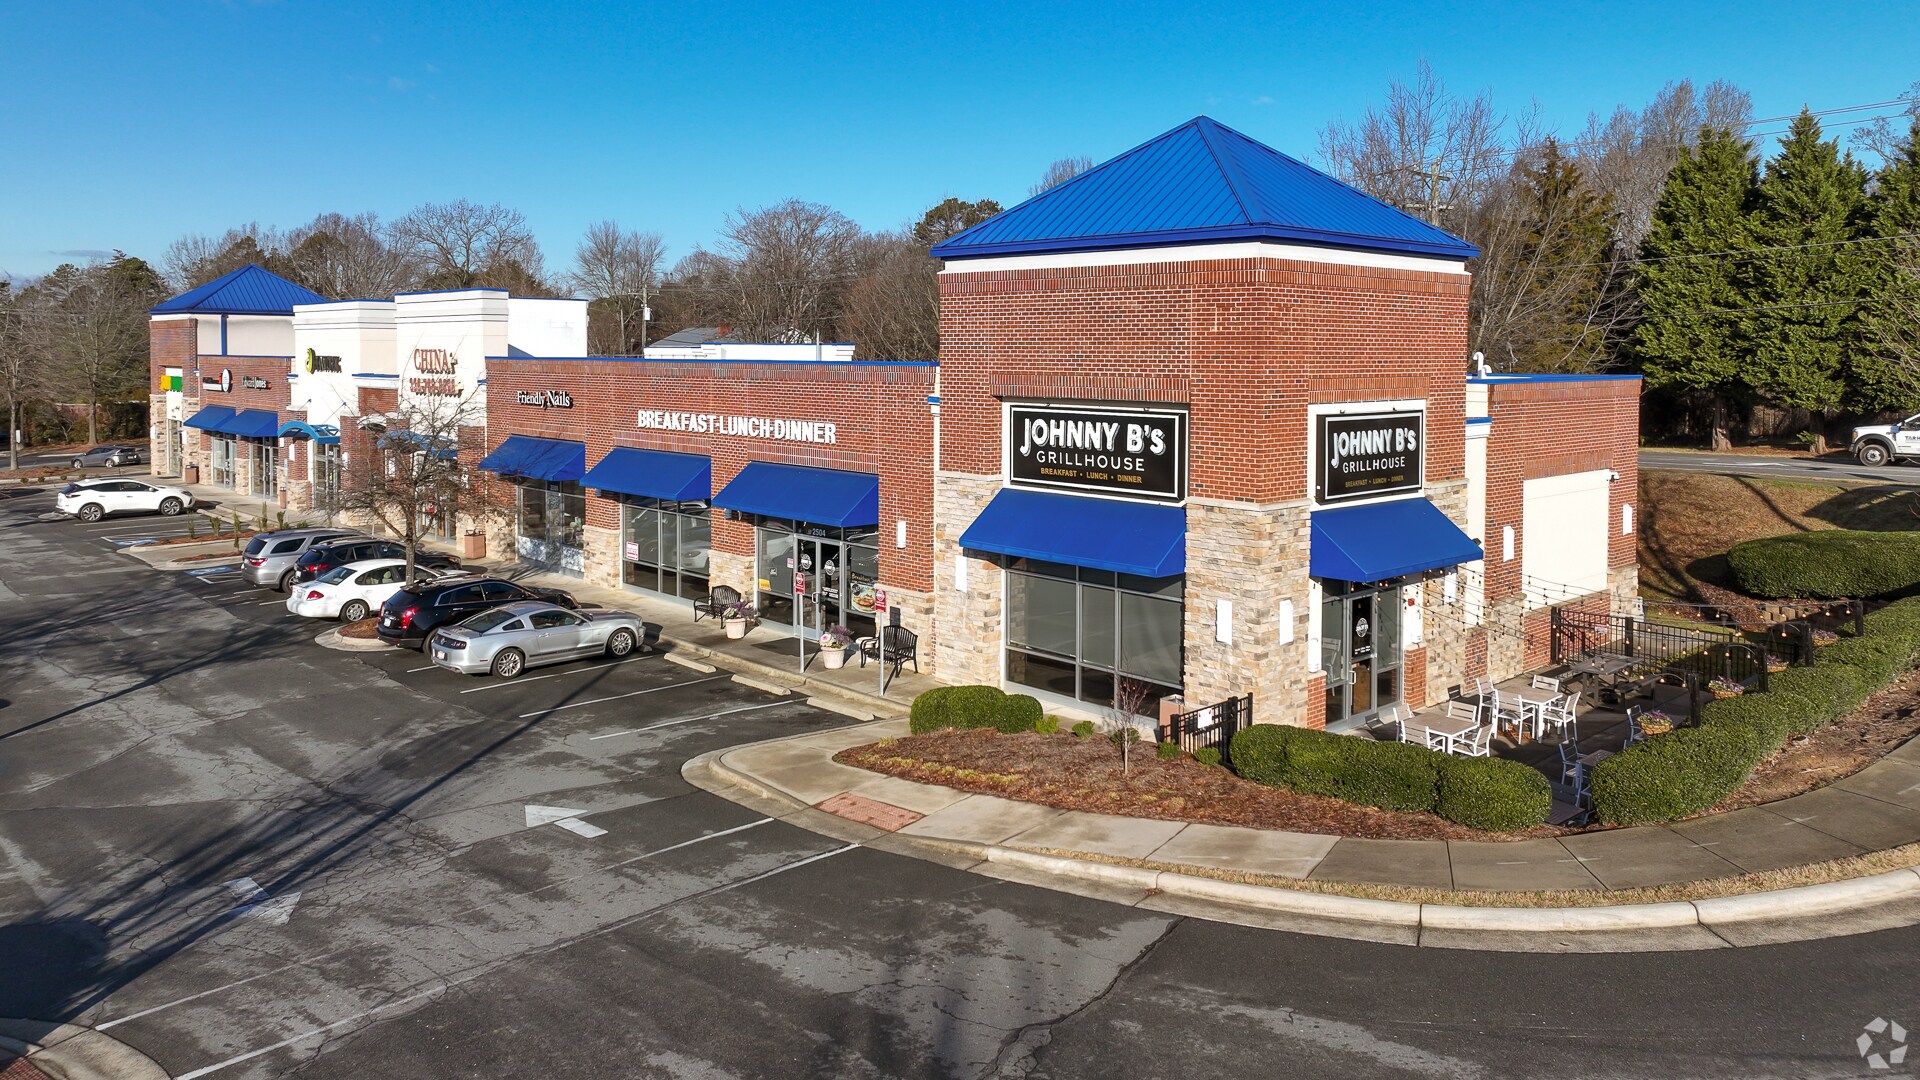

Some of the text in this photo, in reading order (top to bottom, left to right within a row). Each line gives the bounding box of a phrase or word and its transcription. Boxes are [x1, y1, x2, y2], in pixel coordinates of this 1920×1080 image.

[413, 348, 449, 371] CHINA
[517, 390, 570, 408] Friendly Nails
[1019, 417, 1121, 457] JOHNNY
[1330, 428, 1393, 469] JOHNNY
[1036, 450, 1145, 472] GRILLHOUSE
[1342, 456, 1406, 474] GRILLHOUSE
[1040, 467, 1143, 484] BREAKFAST LUNCH DINNER
[1344, 478, 1368, 488] BREAKFAST
[1372, 476, 1387, 485] LUNCH
[812, 527, 826, 537] 2504
